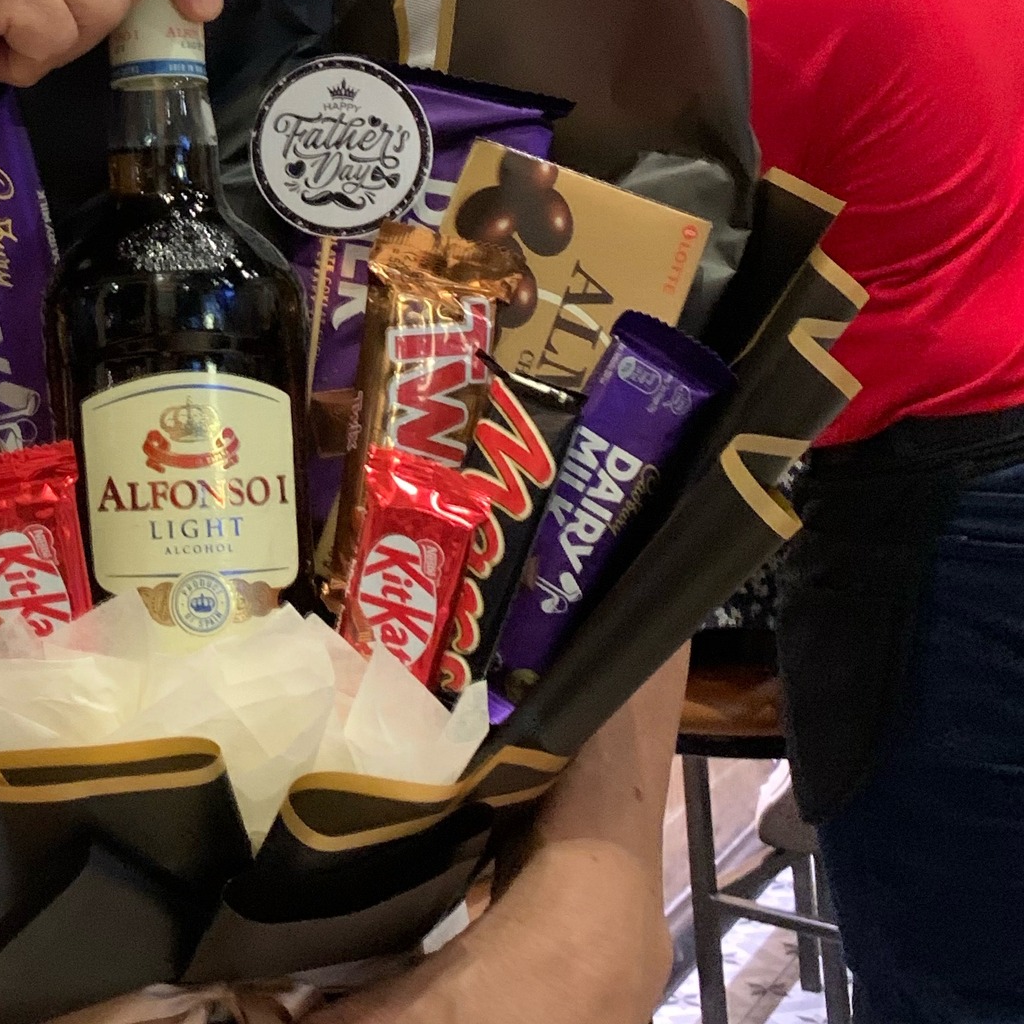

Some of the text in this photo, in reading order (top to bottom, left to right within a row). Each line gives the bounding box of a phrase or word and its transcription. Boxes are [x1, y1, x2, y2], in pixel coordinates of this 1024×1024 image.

[323, 103, 362, 113] HAPPY
[273, 112, 410, 169] Father's
[296, 148, 386, 194] Day
[663, 245, 689, 295] LOTTE
[98, 474, 289, 512] ALFONSO I
[550, 426, 610, 529] MILK
[560, 444, 643, 573] DAIRY
[150, 516, 244, 540] LIGHT
[164, 543, 234, 556] ALCOHOL
[182, 577, 225, 598] PRODUCT
[197, 610, 225, 629] SPAIN
